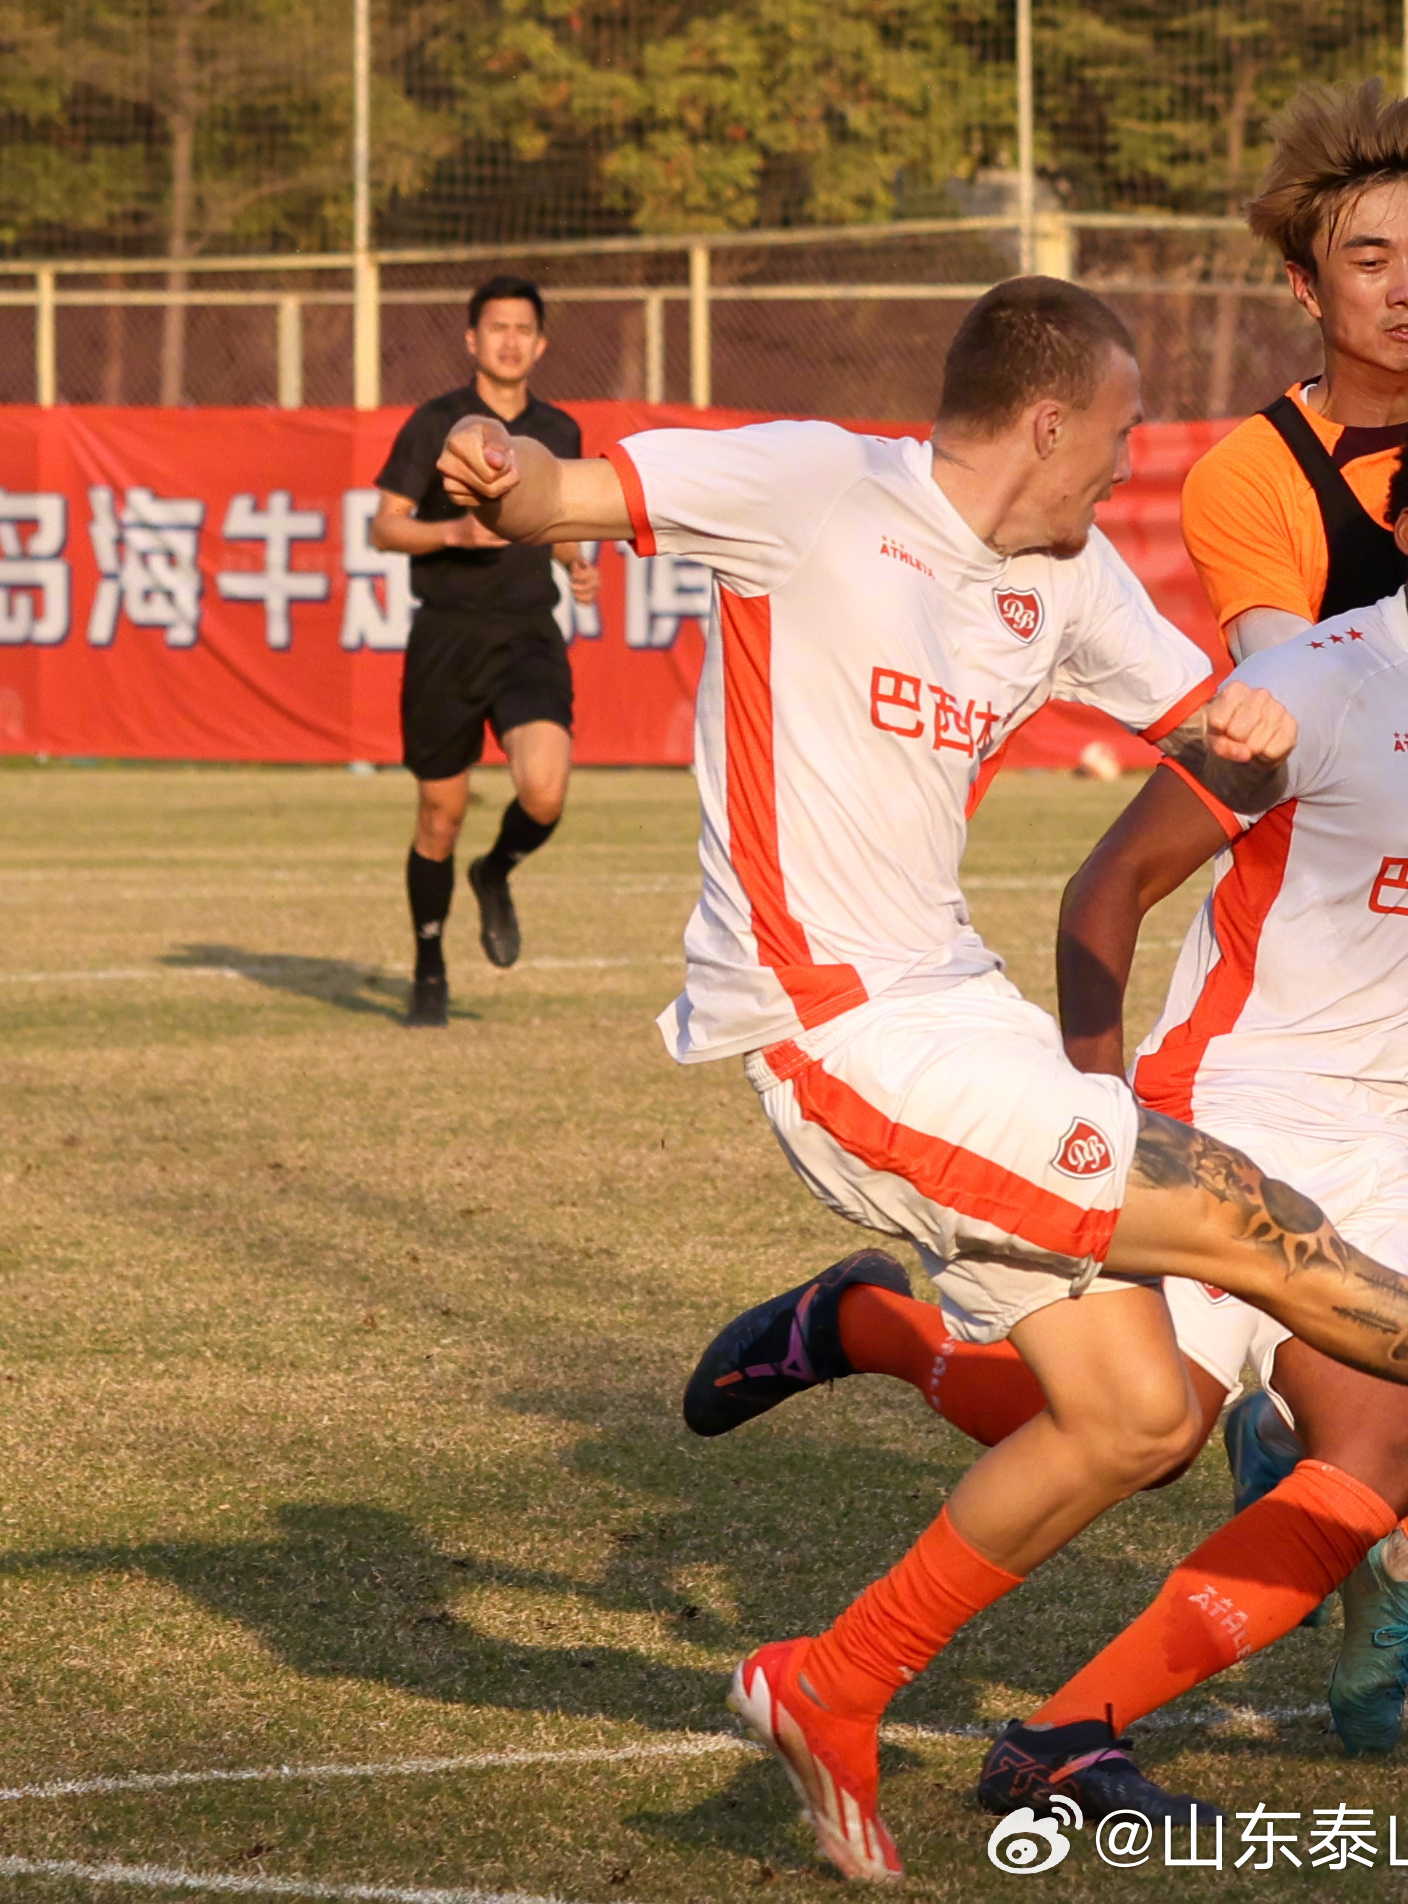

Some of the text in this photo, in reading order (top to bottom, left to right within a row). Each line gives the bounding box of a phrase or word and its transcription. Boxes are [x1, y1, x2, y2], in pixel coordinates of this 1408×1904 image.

[880, 543, 936, 580] ATHLETA
[870, 666, 1013, 759] 巴西体
